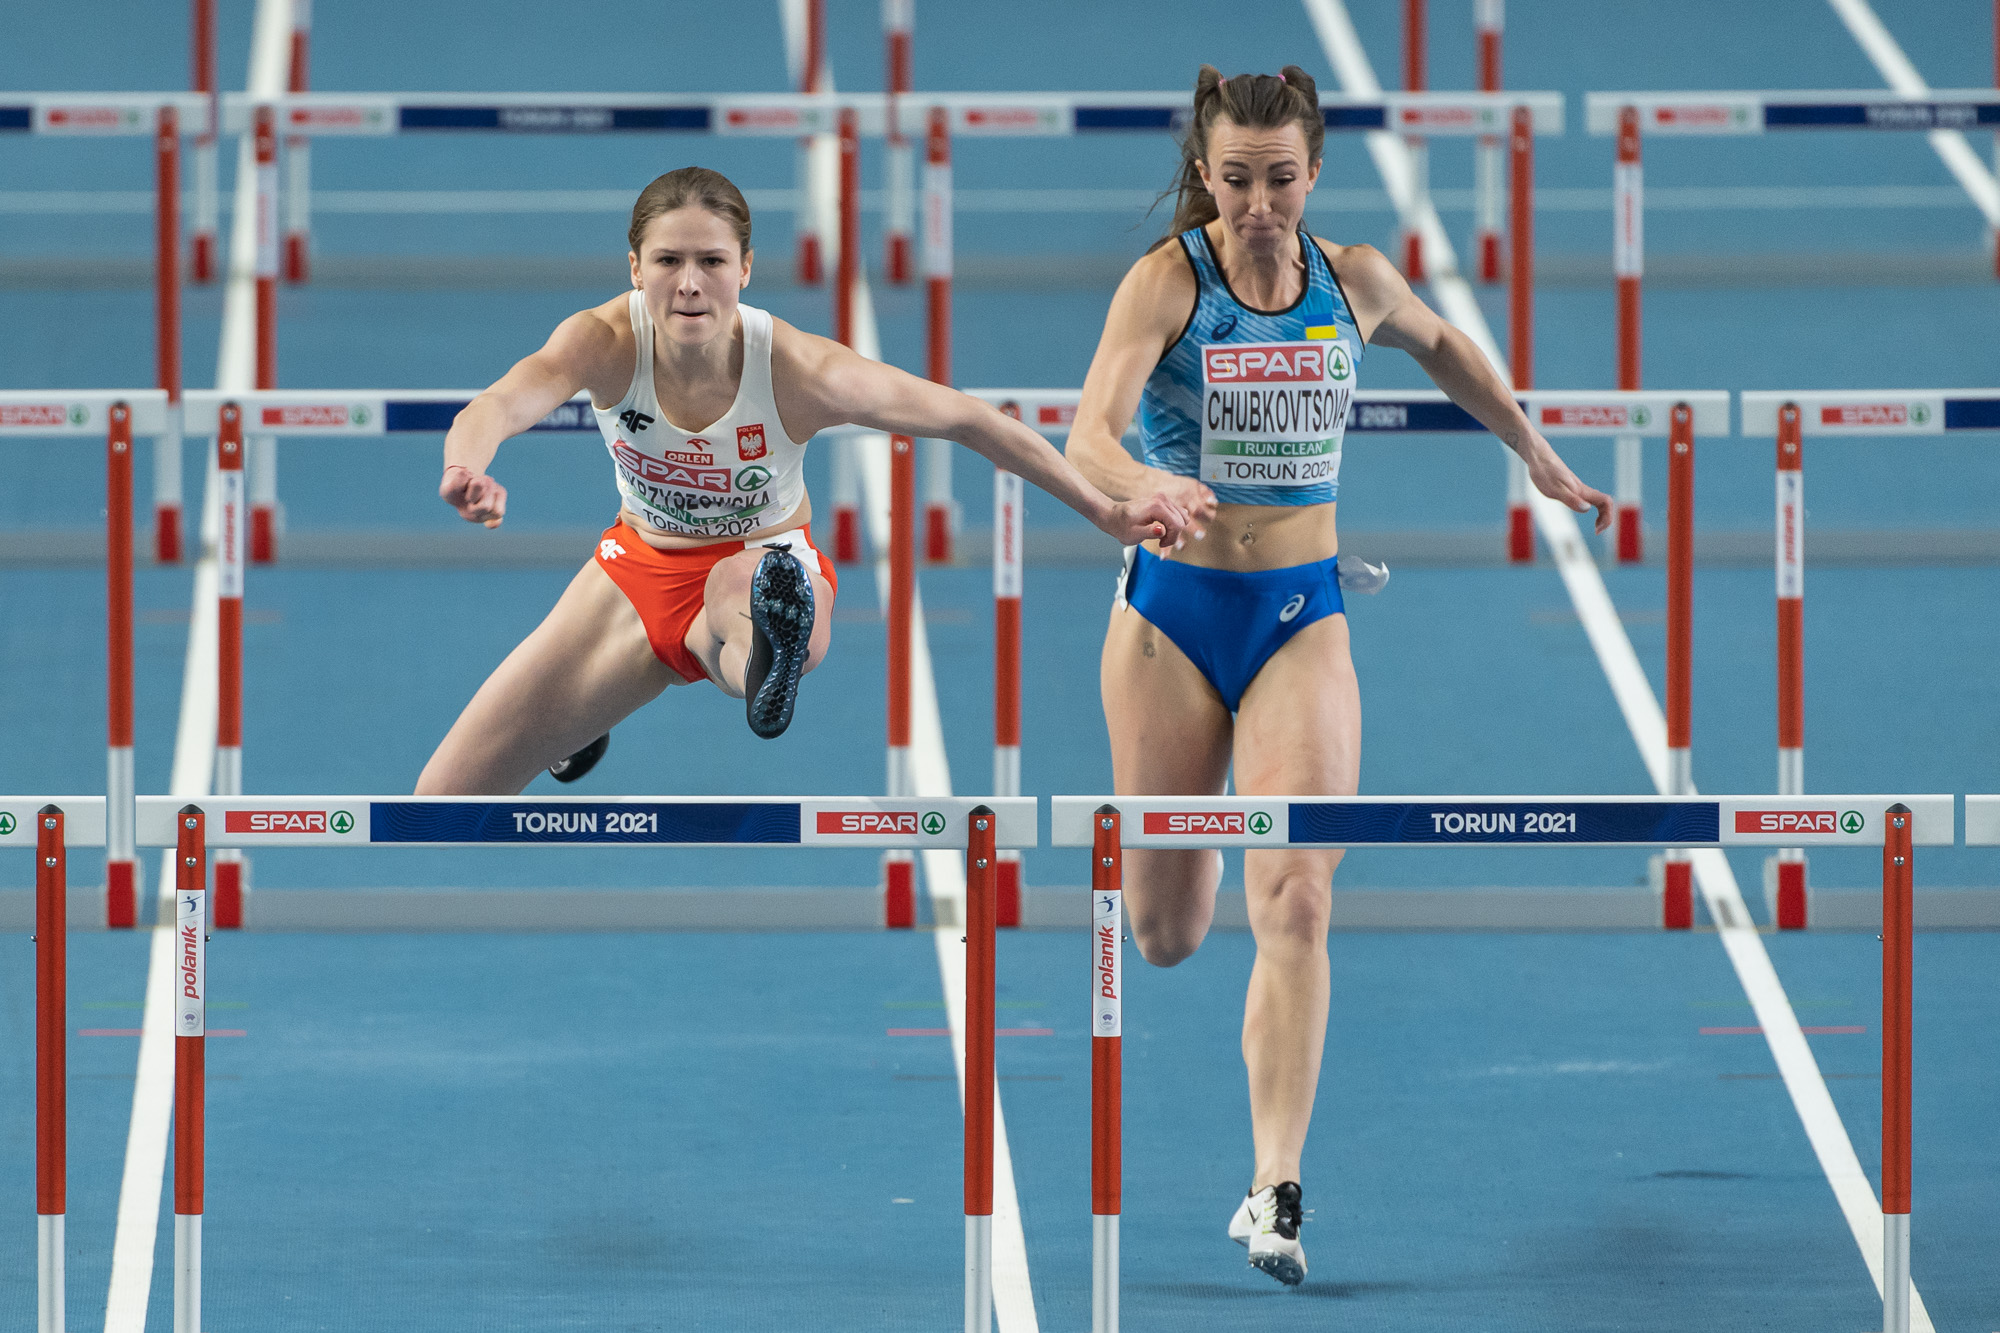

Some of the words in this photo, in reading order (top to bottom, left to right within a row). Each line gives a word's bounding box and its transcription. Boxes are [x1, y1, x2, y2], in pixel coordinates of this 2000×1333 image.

[1209, 350, 1321, 379] SPAR
[1208, 388, 1349, 433] CHUBKOVTSOVA
[738, 425, 762, 433] POLSKA
[667, 452, 711, 464] ORLEN
[1236, 442, 1241, 455] I
[1245, 442, 1277, 455] RUN
[615, 445, 728, 490] SPAR
[1224, 460, 1297, 480] TORUŃ
[1302, 460, 1330, 480] 2021
[250, 813, 324, 831] SPAR
[512, 812, 597, 833] TORUN
[605, 812, 657, 833] 2021
[841, 814, 916, 831] SPAR
[1168, 815, 1243, 832] SPAR
[1431, 812, 1516, 833] TORUN
[1523, 812, 1576, 833] 2021
[1760, 814, 1835, 831] SPAR
[181, 924, 200, 1000] polanik
[1097, 924, 1118, 1000] polanik
